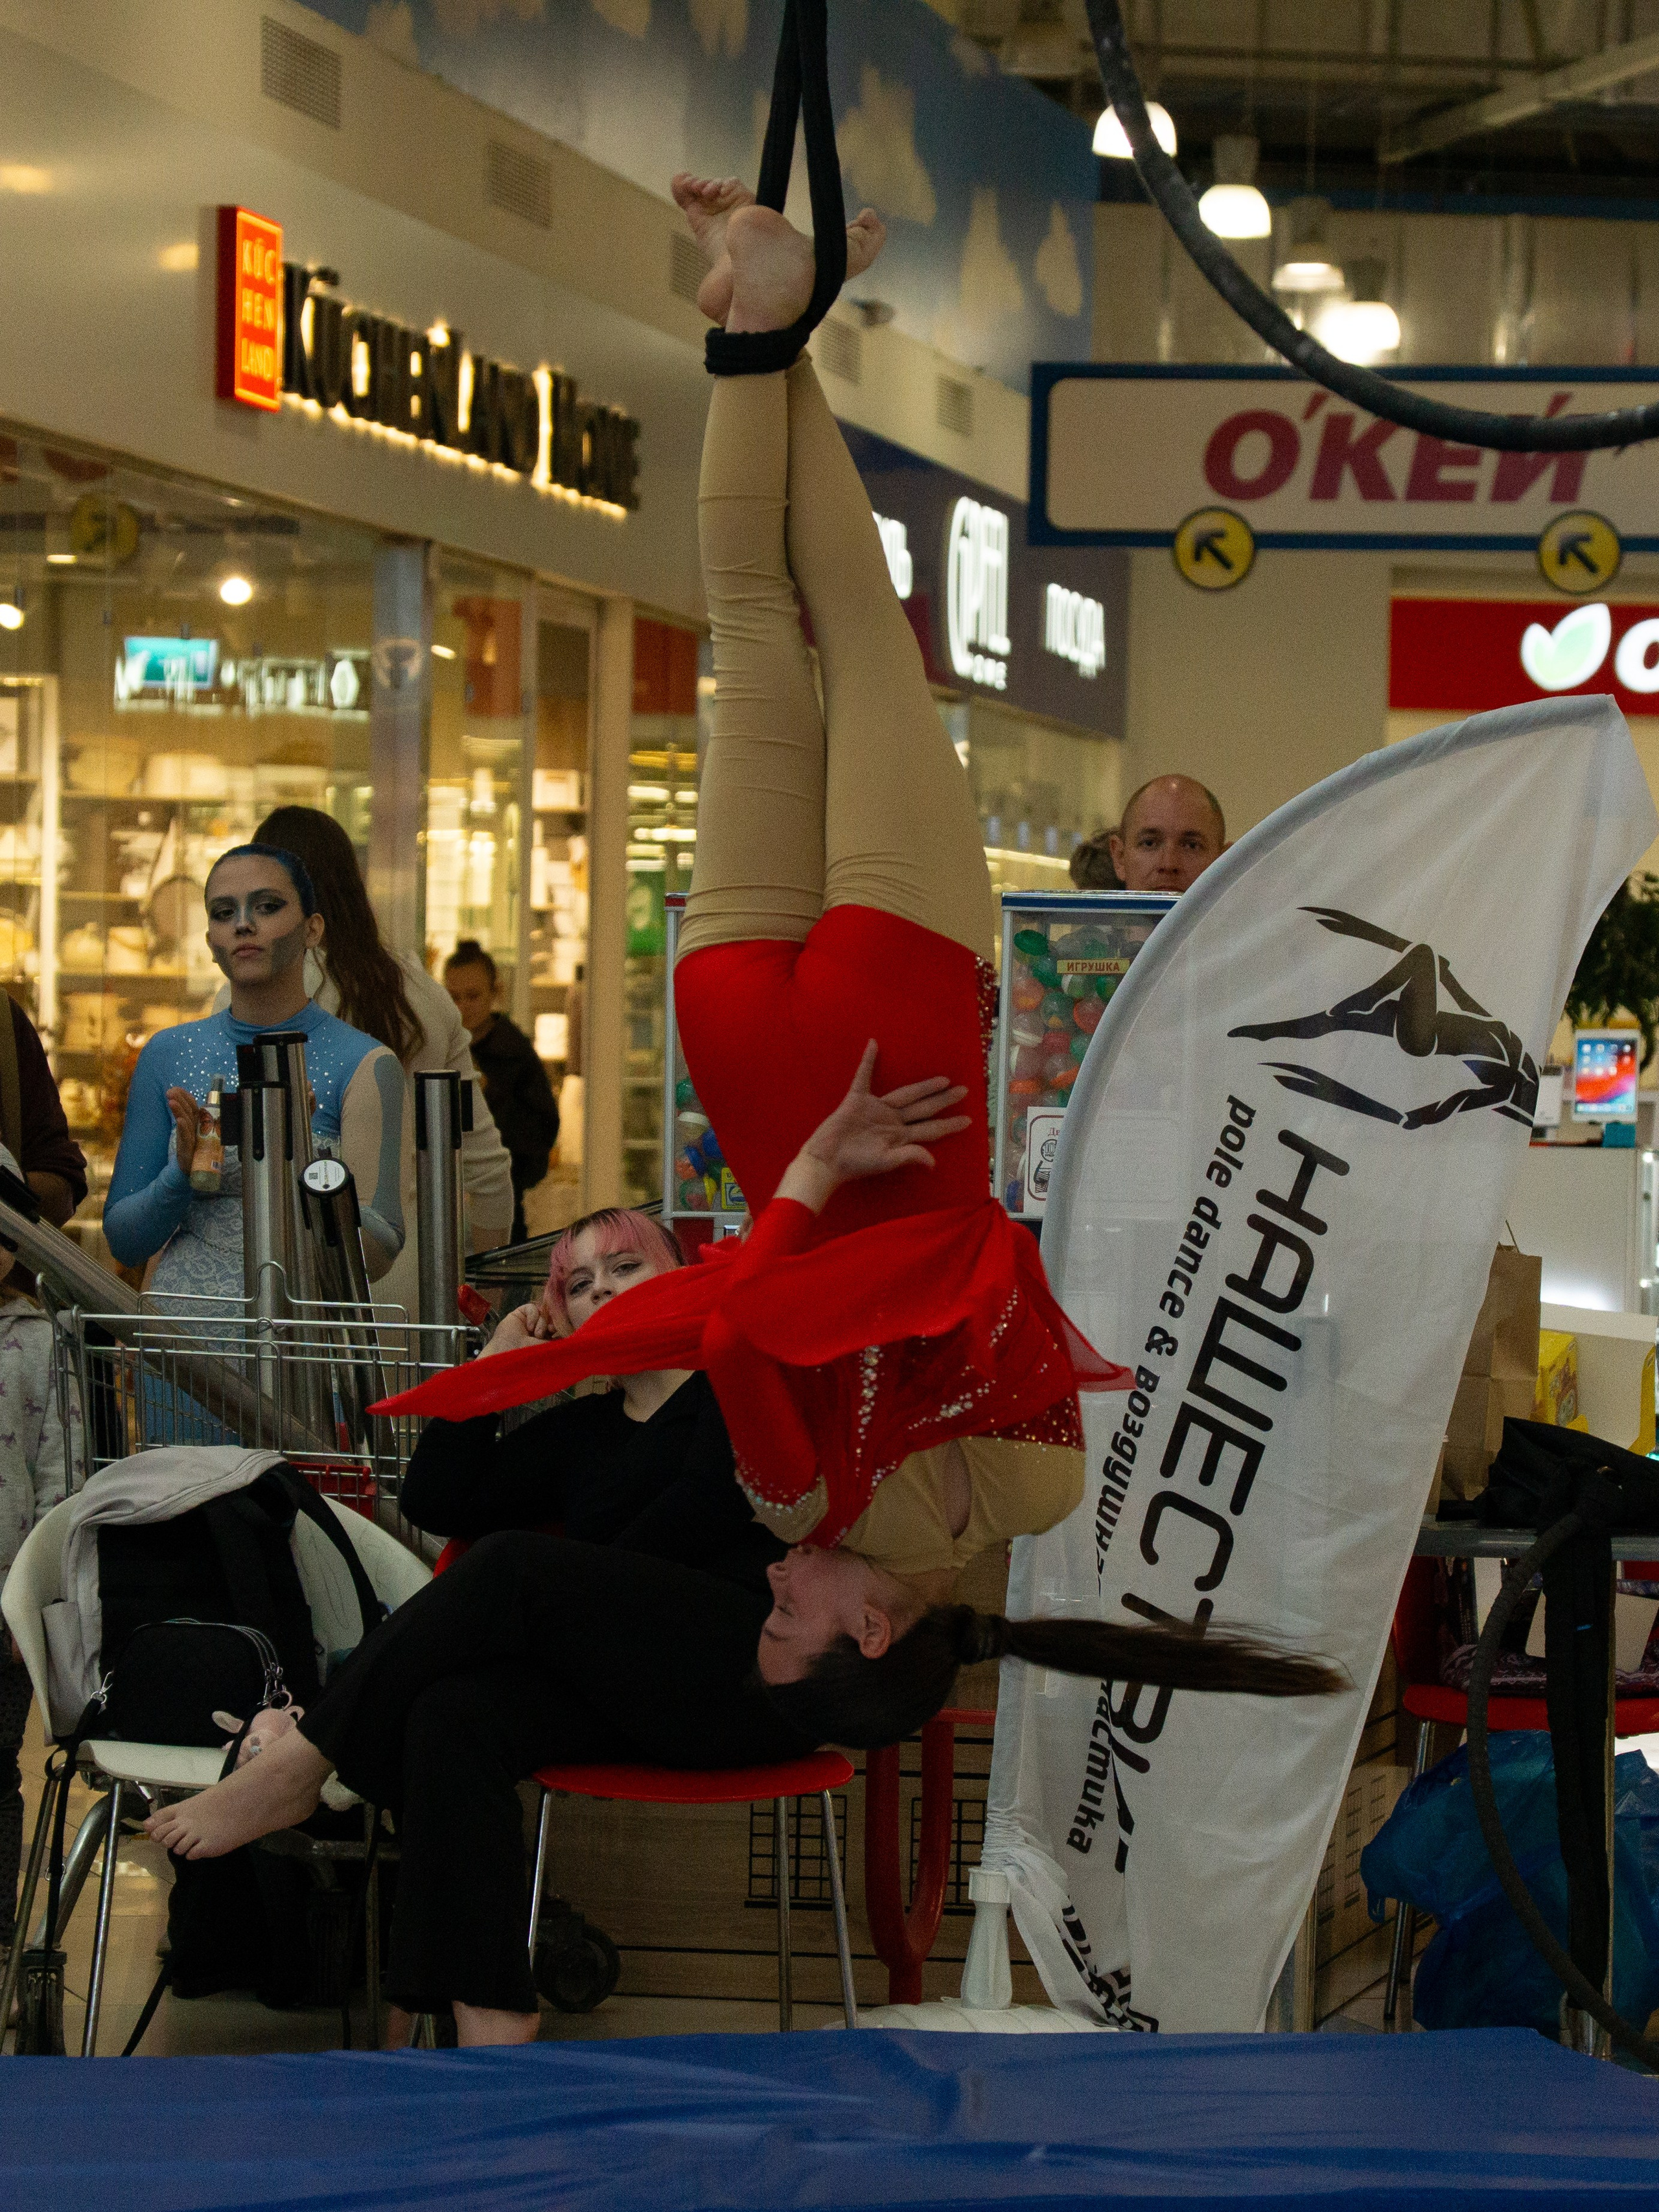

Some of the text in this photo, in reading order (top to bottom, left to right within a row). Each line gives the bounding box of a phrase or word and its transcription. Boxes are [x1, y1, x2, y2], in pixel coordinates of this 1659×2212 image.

[242, 287, 275, 331] HEN
[241, 337, 274, 381] LAND
[1067, 962, 1120, 972] ИГРУШКА
[1206, 1095, 1257, 1188] pole
[1159, 1196, 1222, 1319] dance
[1145, 1325, 1178, 1356] &
